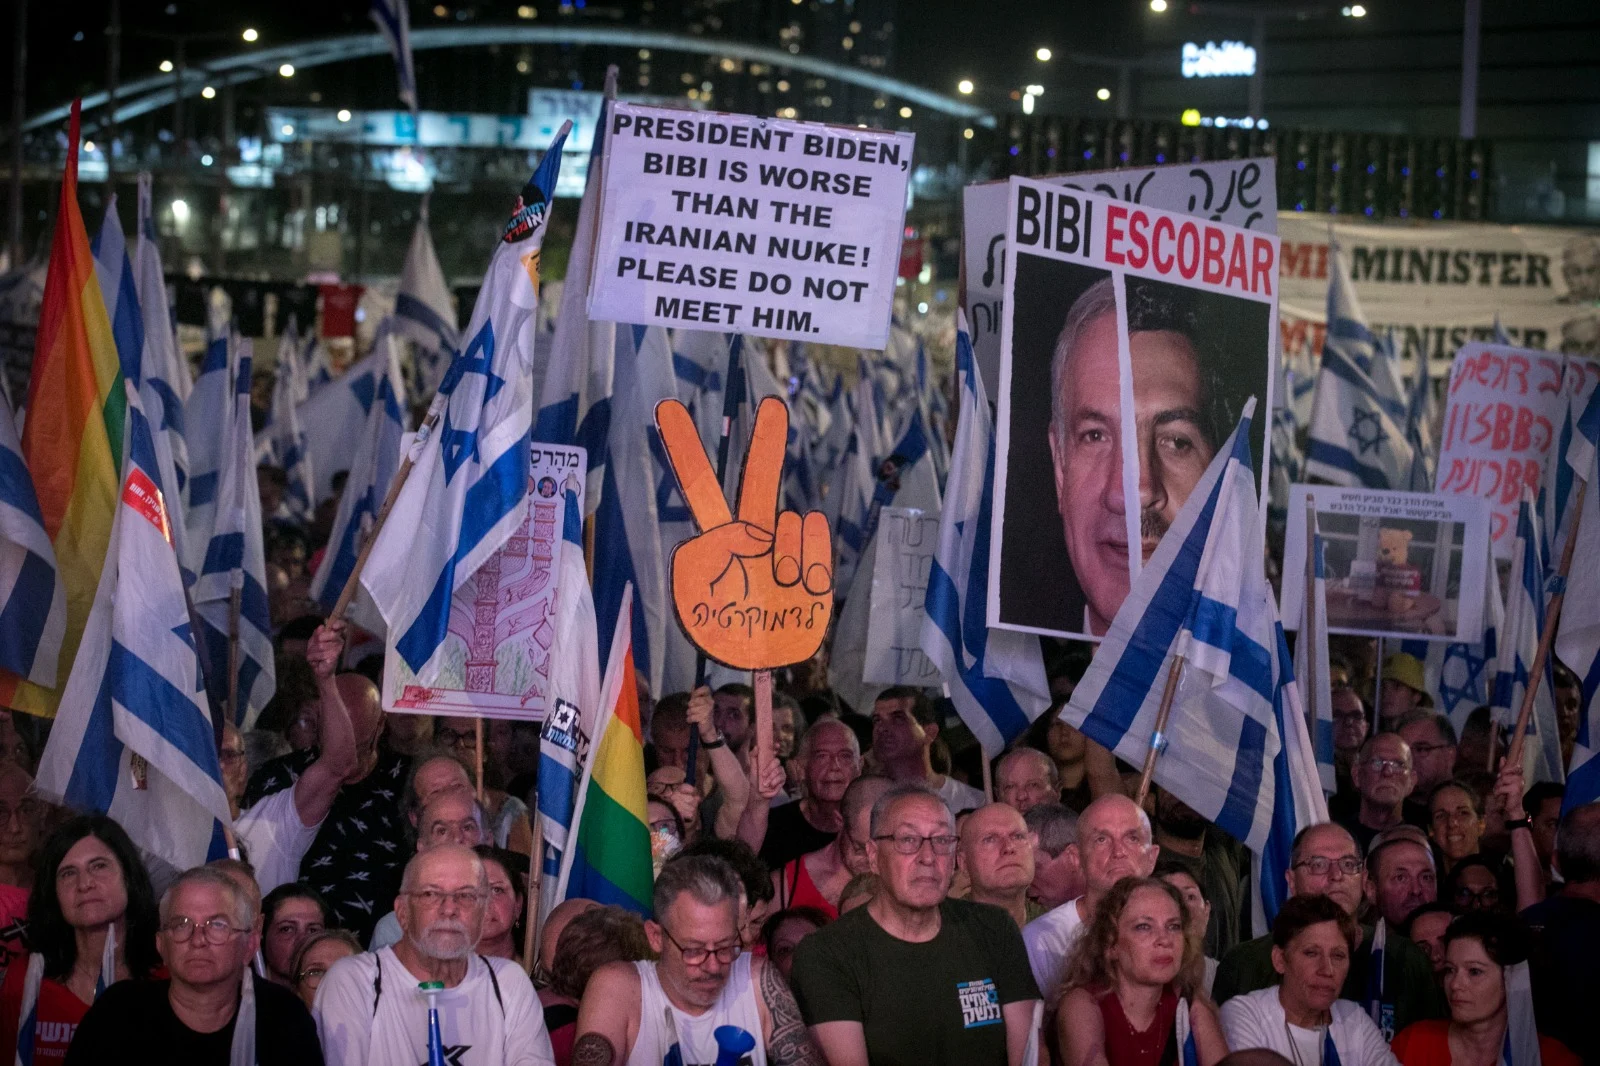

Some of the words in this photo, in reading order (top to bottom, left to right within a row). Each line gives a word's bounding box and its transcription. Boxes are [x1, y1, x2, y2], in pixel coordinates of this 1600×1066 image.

[613, 113, 793, 152] PRESIDENT
[803, 134, 908, 172] BIDEN,
[643, 152, 708, 179] BIBI
[718, 160, 748, 183] IS
[759, 164, 872, 198] WORSE
[672, 190, 759, 220] THAN
[770, 200, 833, 228] THE
[624, 221, 757, 255] IRANIAN
[767, 236, 870, 268] NUKE!
[1016, 185, 1093, 258] BIBI
[1105, 204, 1275, 297] ESCOBAR
[617, 256, 738, 290] PLEASE
[748, 271, 792, 295] DO
[802, 277, 869, 303] NOT
[1351, 246, 1552, 287] MINISTER
[654, 296, 742, 325] MEET
[752, 306, 820, 334] HIM.
[692, 602, 825, 638] לדמוקרטיה
[962, 1003, 1001, 1026] לנשק
